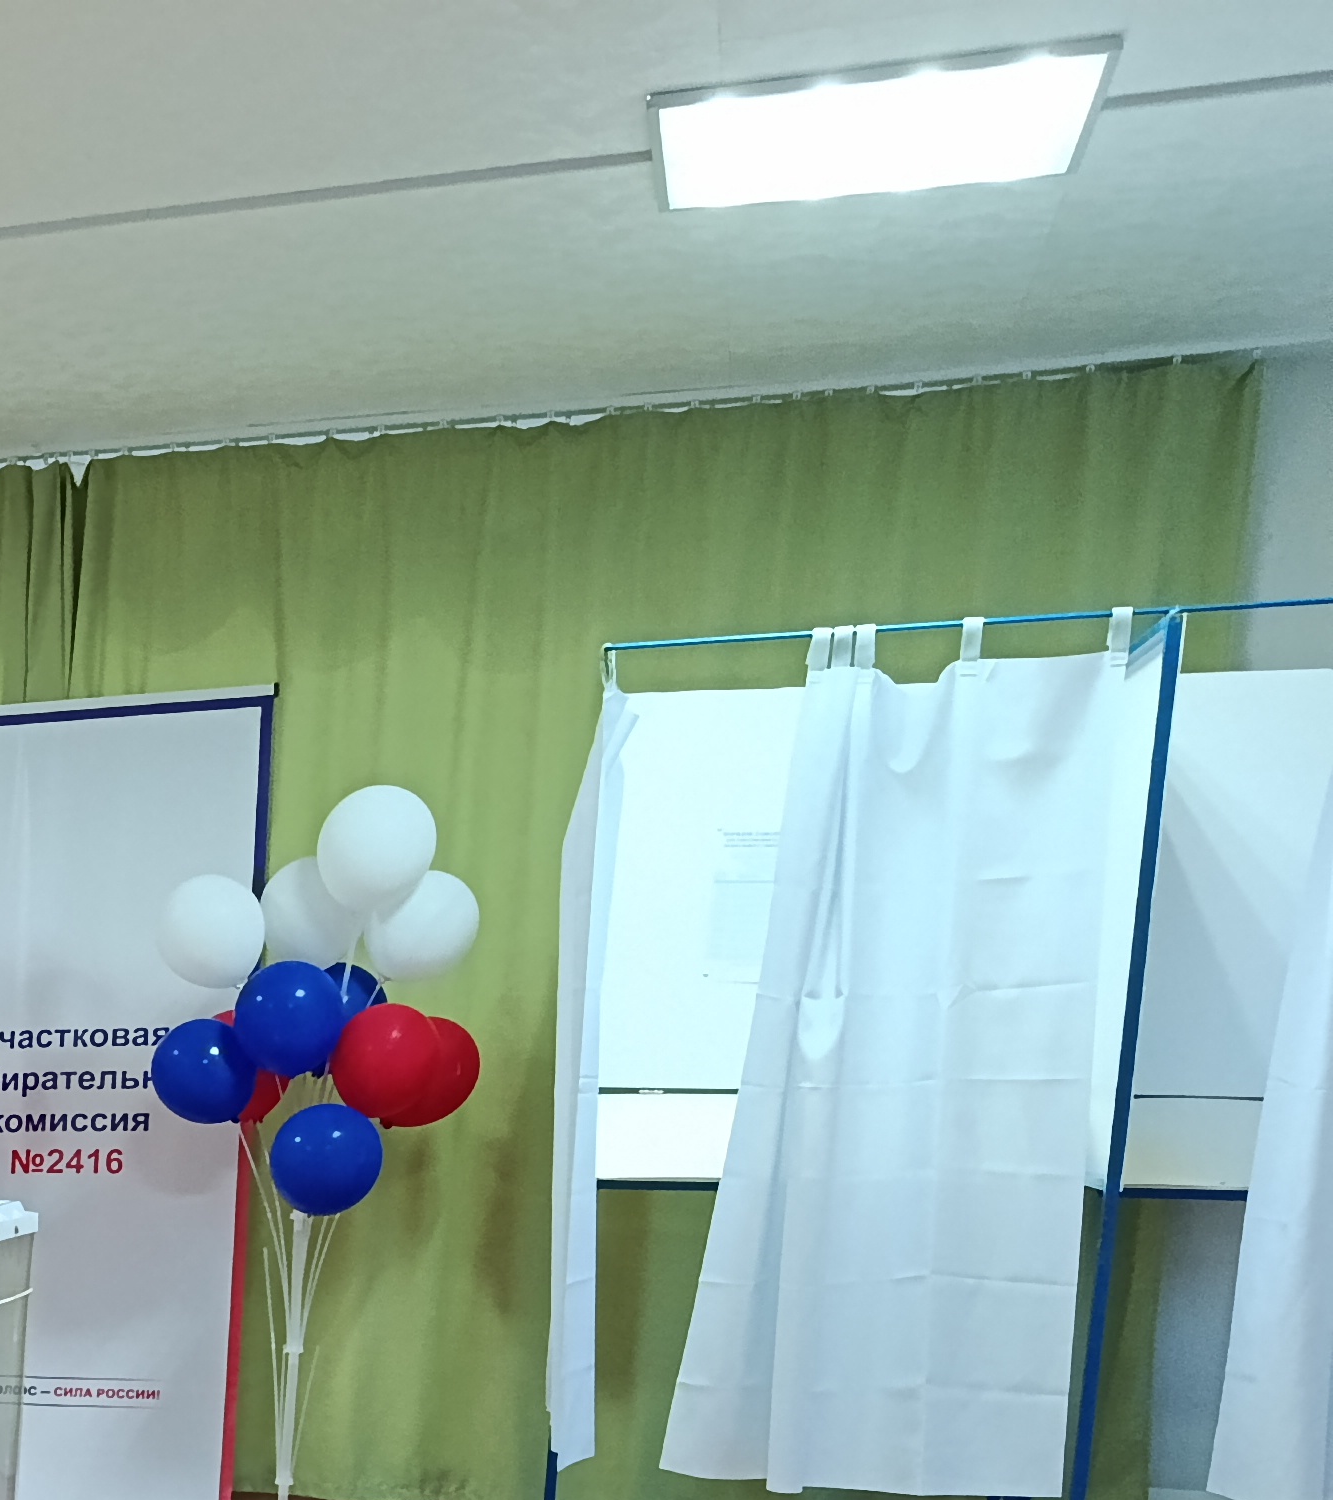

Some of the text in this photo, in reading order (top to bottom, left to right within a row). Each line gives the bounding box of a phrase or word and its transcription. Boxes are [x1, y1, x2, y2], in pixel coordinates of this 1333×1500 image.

[10, 1148, 124, 1175] №2416
[53, 1387, 93, 1398] СИЛА
[96, 1388, 161, 1400] РОССИИ!
